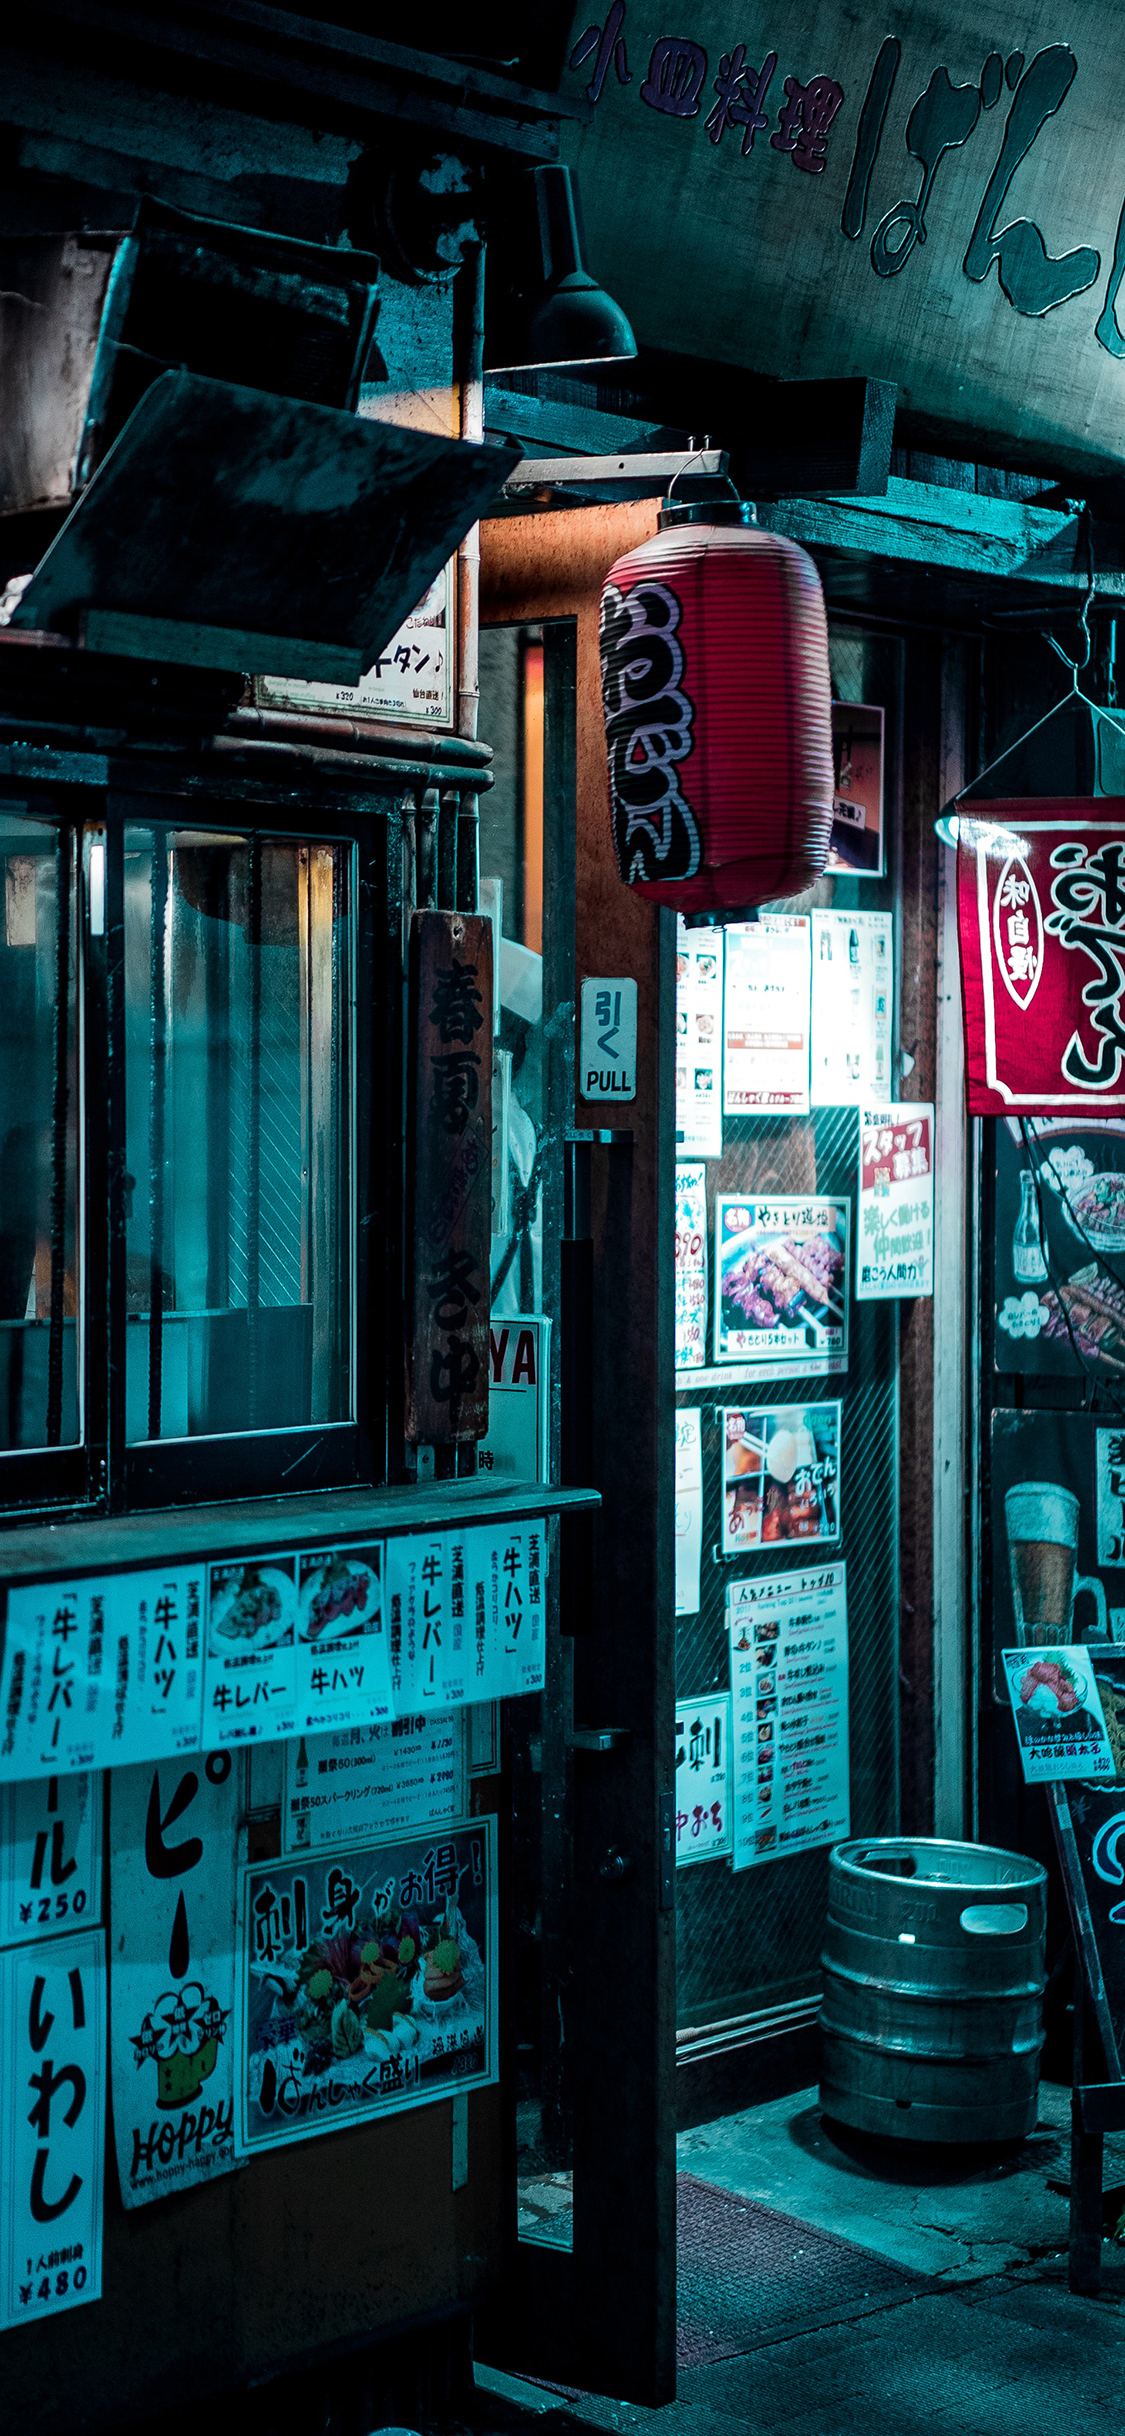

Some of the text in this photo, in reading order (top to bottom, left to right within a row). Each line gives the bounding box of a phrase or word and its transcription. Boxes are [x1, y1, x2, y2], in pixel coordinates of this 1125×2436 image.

[569, 0, 843, 174] 小皿料理
[595, 991, 621, 1059] 引く
[587, 1071, 631, 1092] PULL
[863, 1120, 923, 1166] スタッフ
[892, 1146, 929, 1181] 募集
[426, 958, 484, 1424] 春夏冬中
[863, 1200, 930, 1236] 楽しく働ける
[861, 1262, 917, 1283] 磨こう人間力
[794, 1455, 836, 1497] おでん
[451, 1545, 464, 1618] 芝浦直送
[529, 1534, 540, 1604] 芝浦直送
[503, 1536, 522, 1654] 「牛ハツ」
[739, 1585, 791, 1602] 人気メニュー
[421, 1543, 443, 1696] 「牛レバー」
[151, 1582, 178, 1714] 「牛ハツ」
[41, 1592, 78, 1763] 「牛レバー」
[213, 1681, 287, 1712] 牛レバー
[311, 1666, 364, 1695] 牛ハツ
[391, 1715, 426, 1737] 割引中
[1029, 1741, 1101, 1760] 大吟醸明太子
[20, 1890, 86, 1923] ¥250
[256, 2016, 297, 2051] 豪華
[28, 1968, 86, 2224] いわし
[260, 2048, 421, 2115] ばんしゃく盛り
[130, 2098, 233, 2178] Hoppy
[26, 2244, 84, 2275] 1人前刺身
[19, 2267, 87, 2303] ¥480
